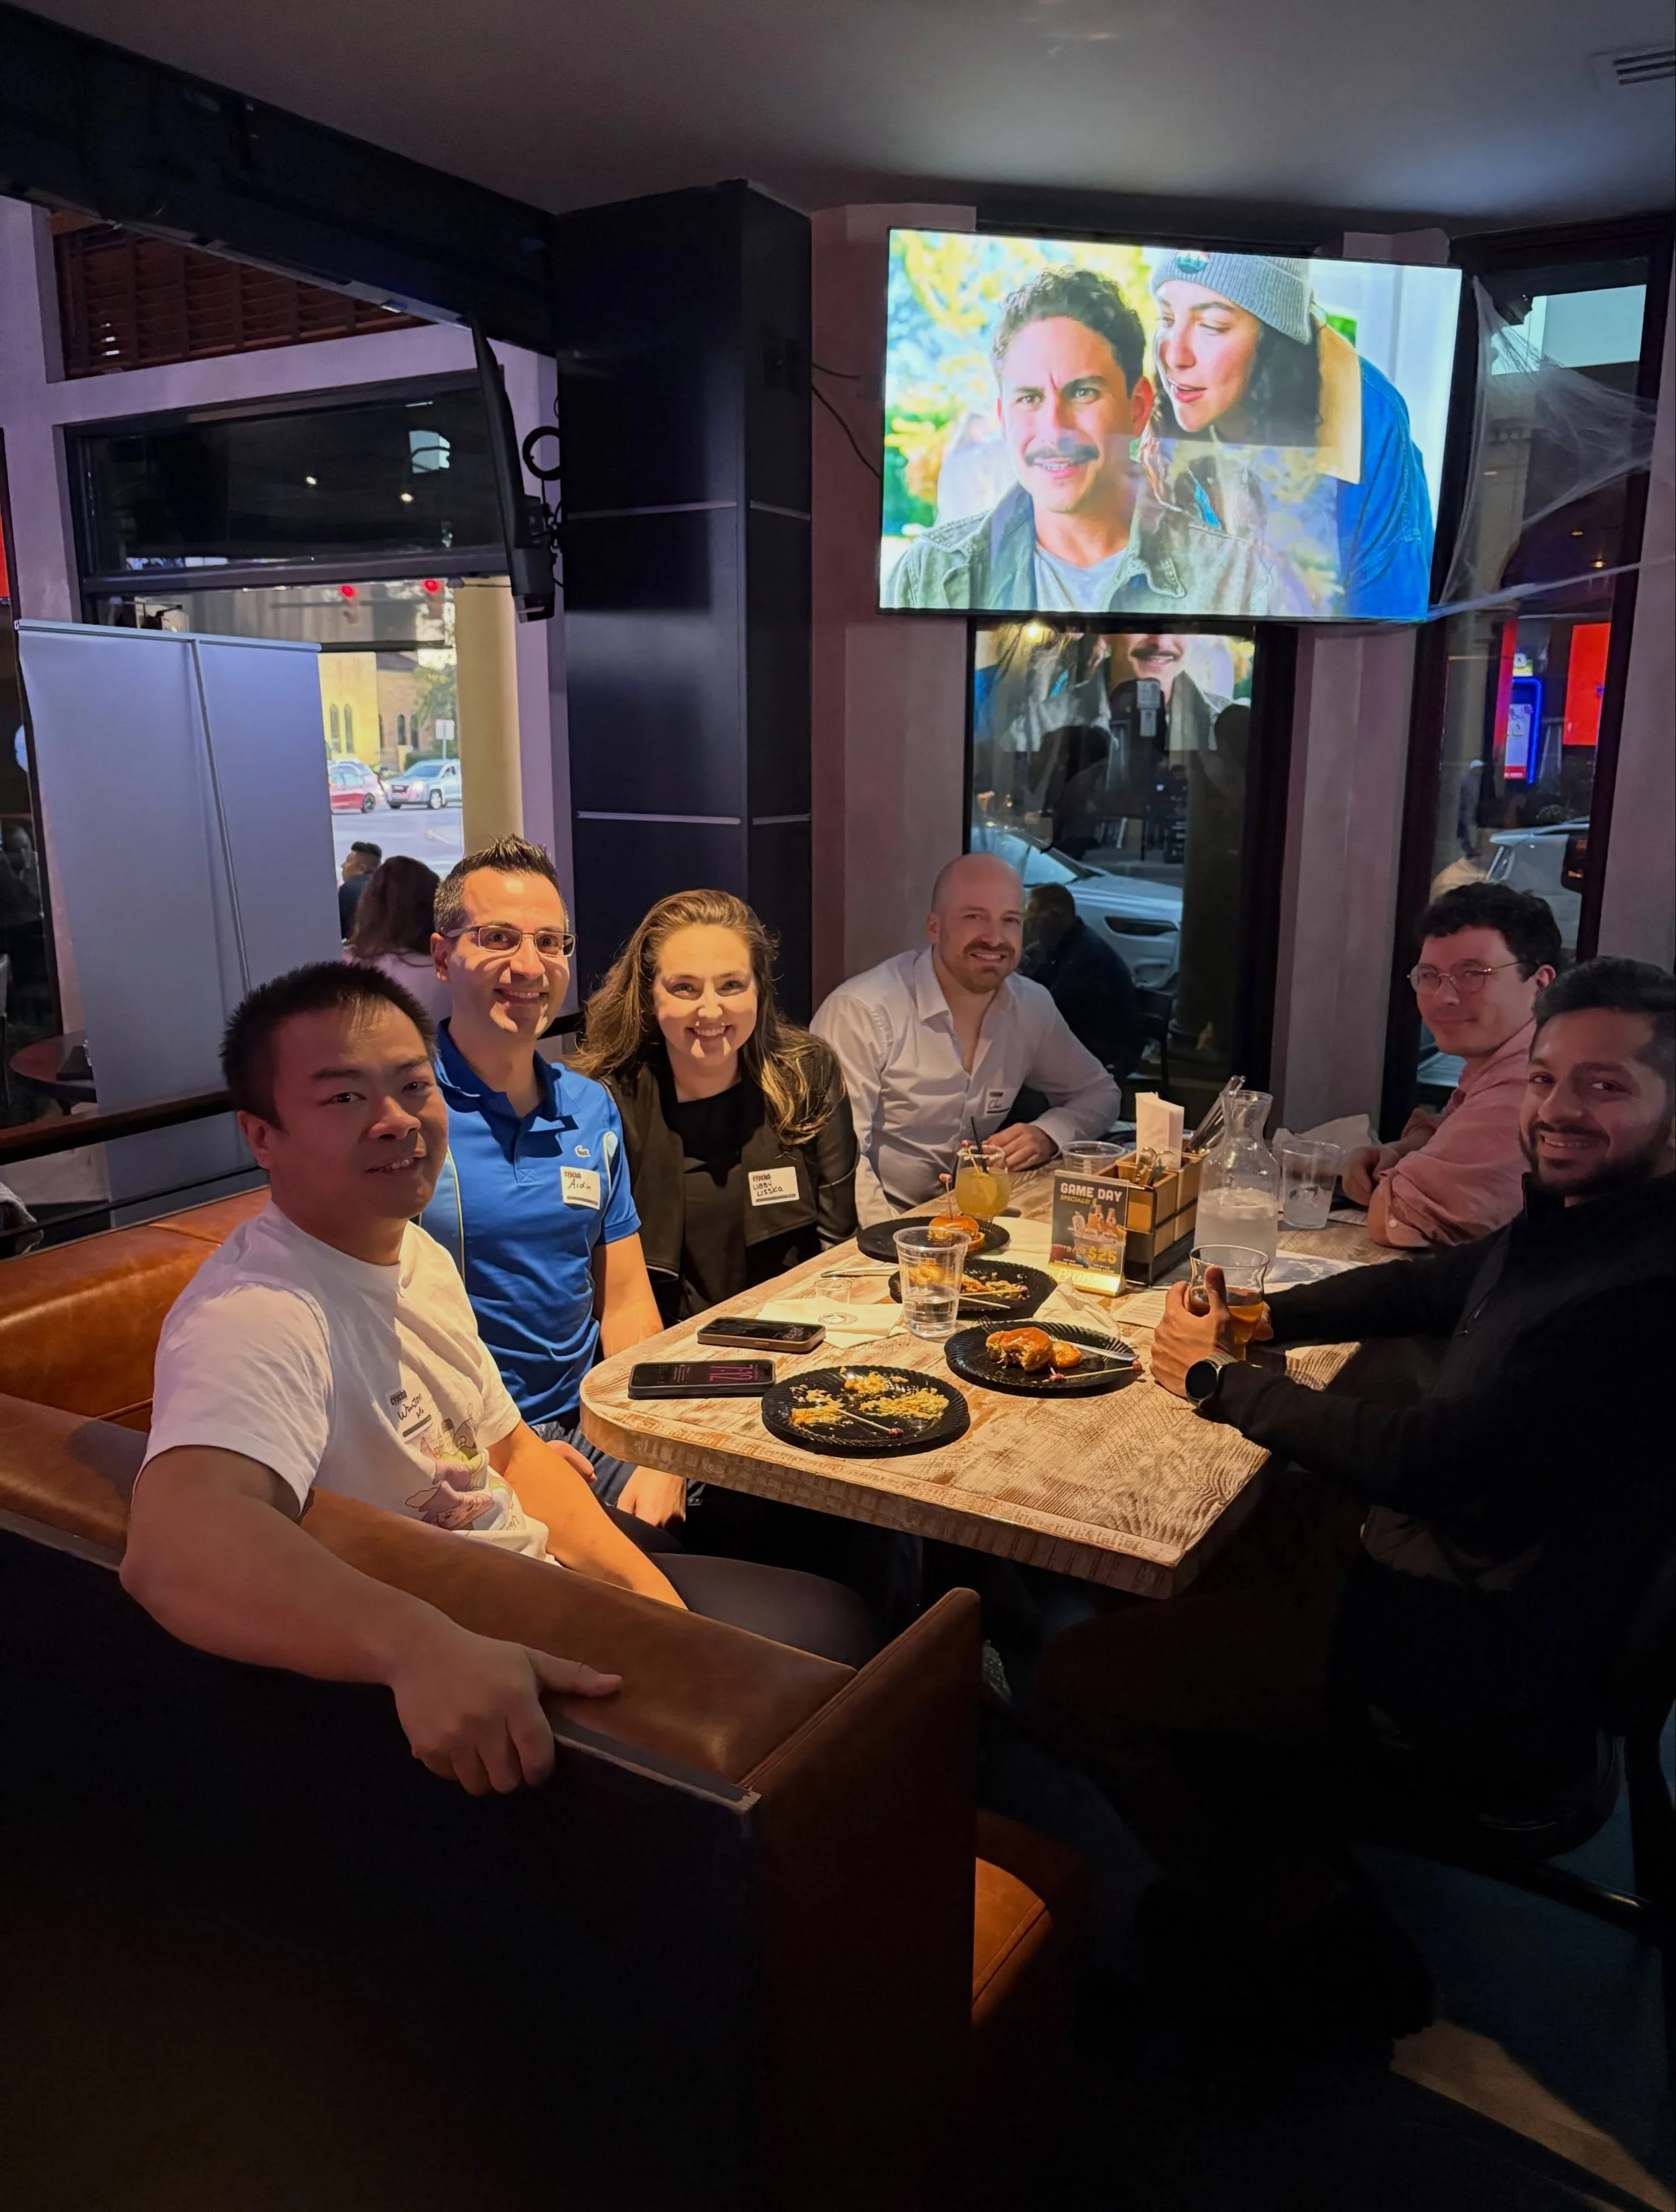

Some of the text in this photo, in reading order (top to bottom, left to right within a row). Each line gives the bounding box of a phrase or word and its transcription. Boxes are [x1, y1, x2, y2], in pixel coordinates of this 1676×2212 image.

[1061, 1182, 1123, 1202] GAME DAY
[1087, 1245, 1118, 1264] $25
